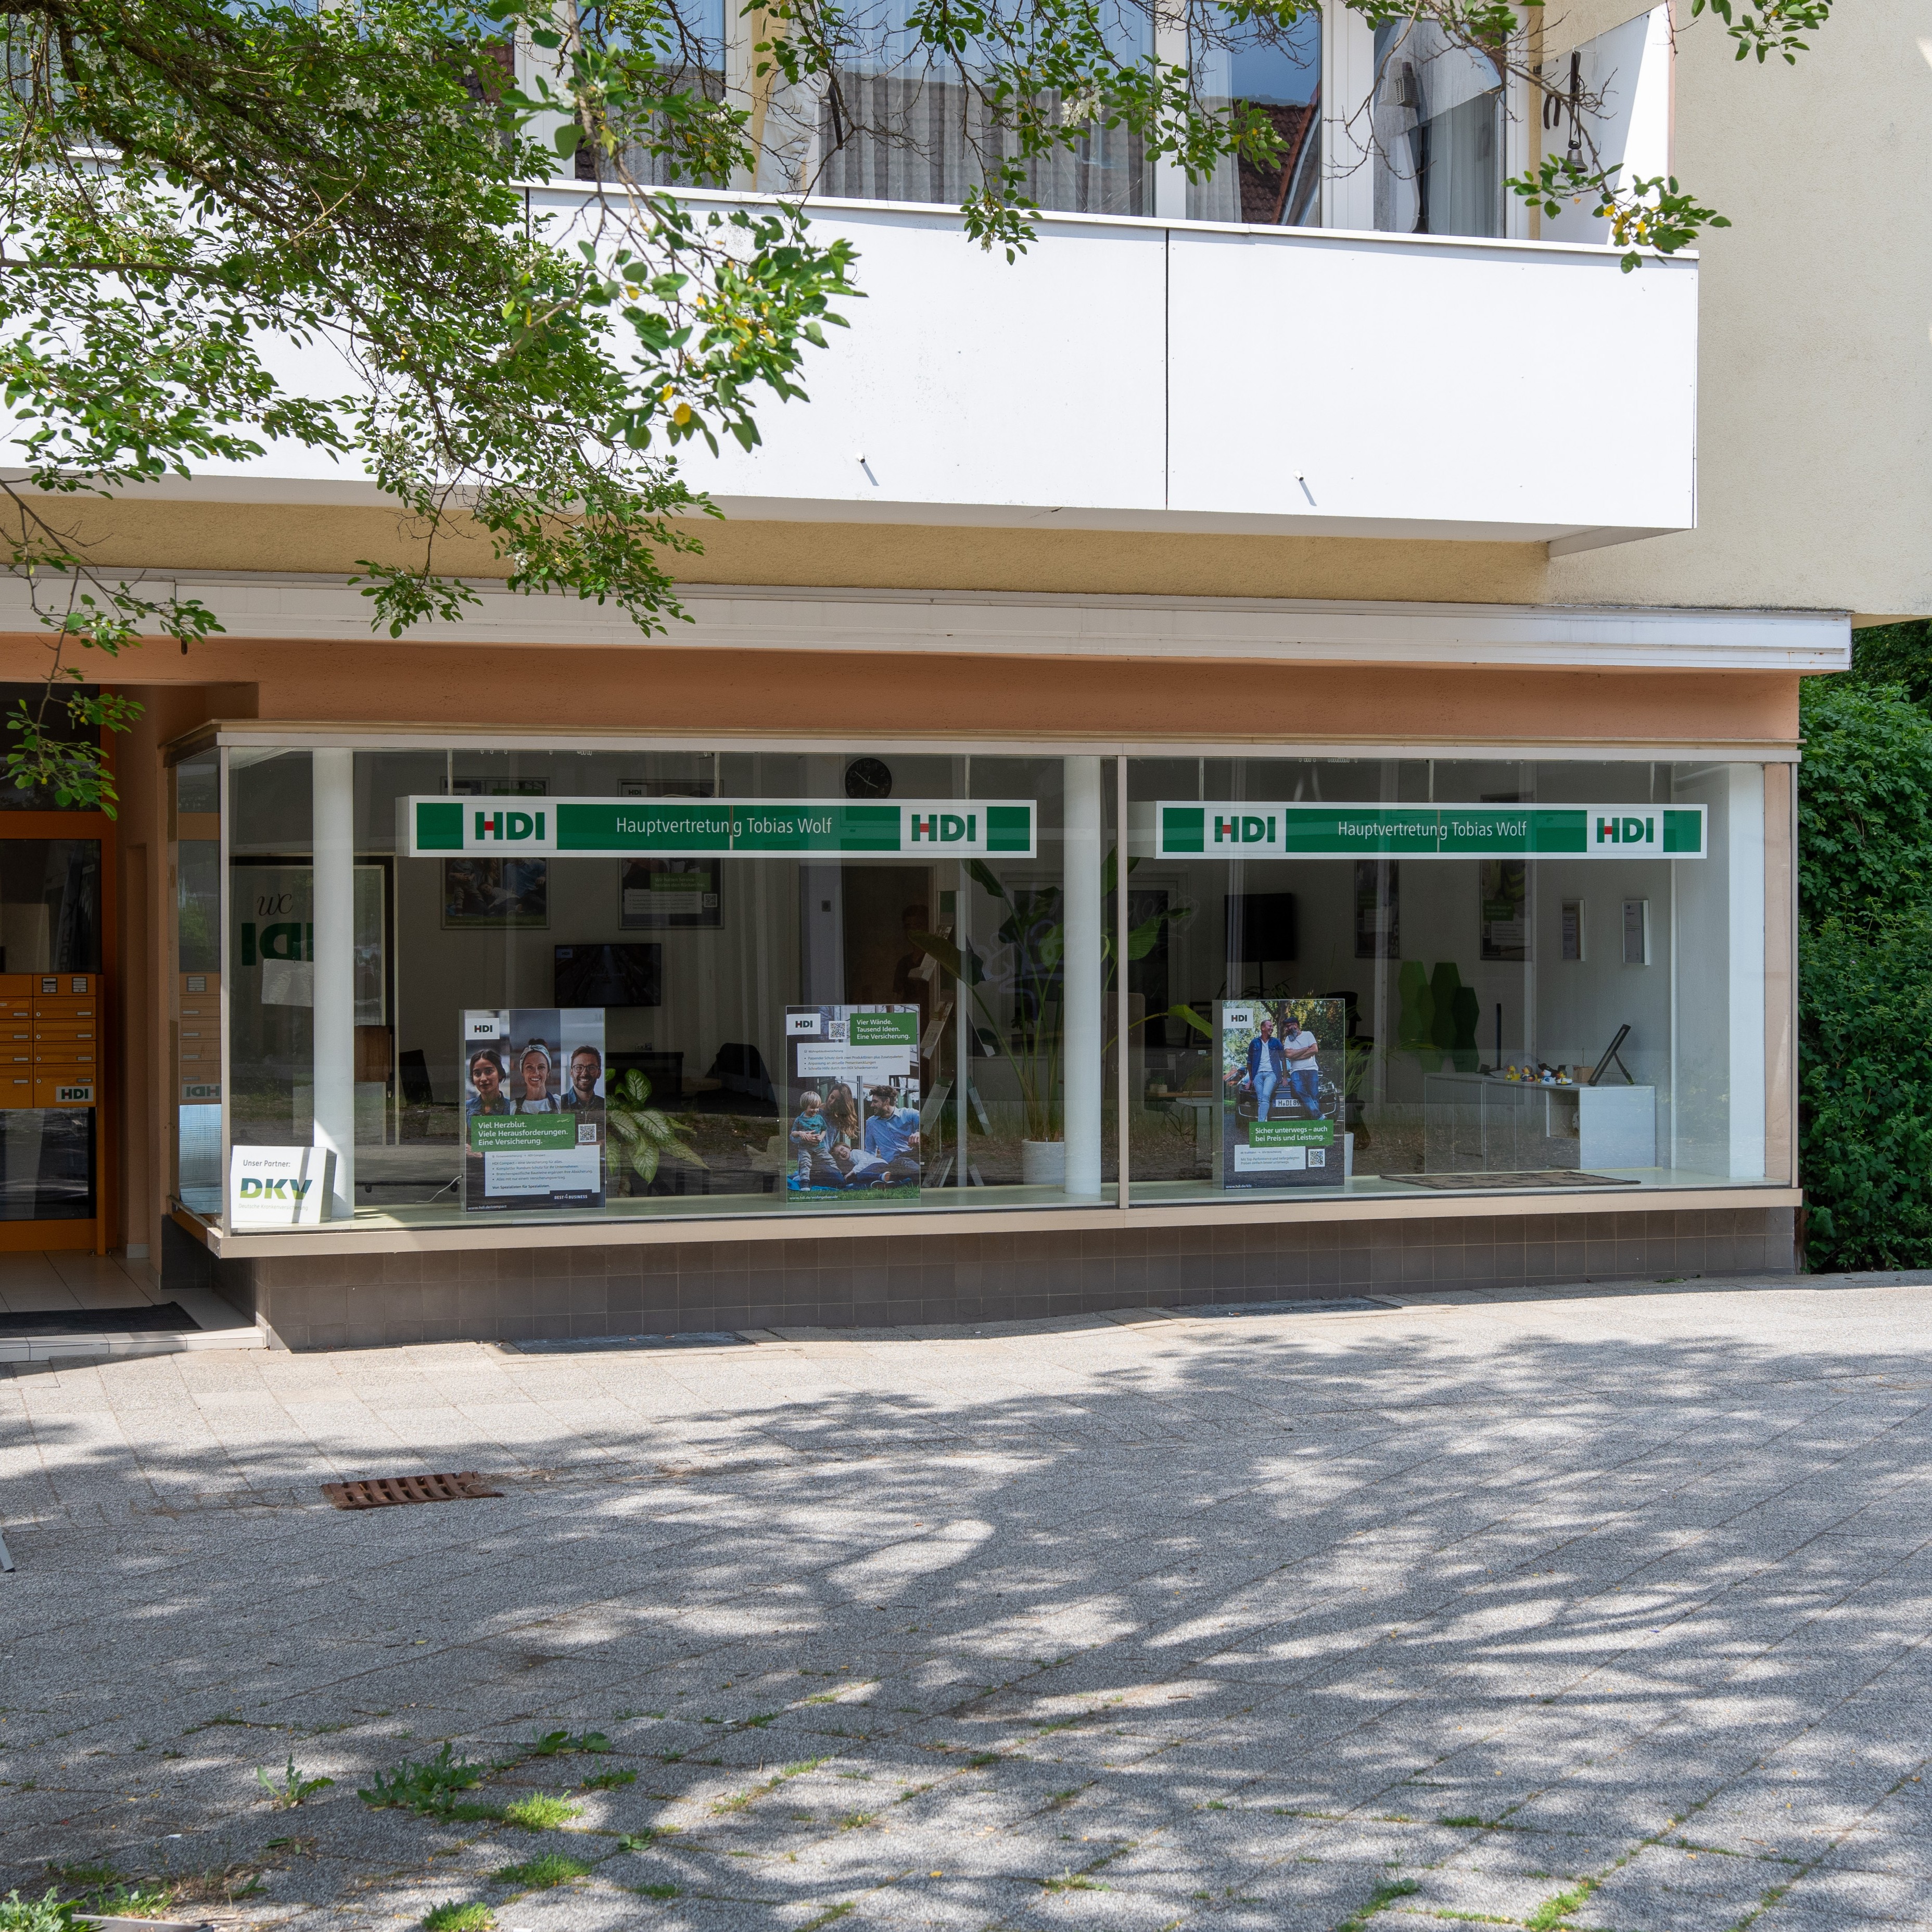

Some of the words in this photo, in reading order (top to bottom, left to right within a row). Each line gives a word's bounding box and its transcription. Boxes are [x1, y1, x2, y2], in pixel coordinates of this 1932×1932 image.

[475, 811, 545, 840] HDI
[617, 818, 742, 837] Hauptvertretung
[747, 818, 794, 833] Tobias
[797, 817, 832, 833] Wolf
[911, 814, 976, 842] HDI
[1214, 816, 1276, 843] HDI
[1338, 821, 1447, 841] Hauptvertretung
[1451, 821, 1493, 837] Tobias
[1496, 821, 1527, 837] Wolf
[1597, 818, 1654, 844] HDI
[61, 1088, 88, 1099] HDI
[240, 1178, 313, 1200] DKV
